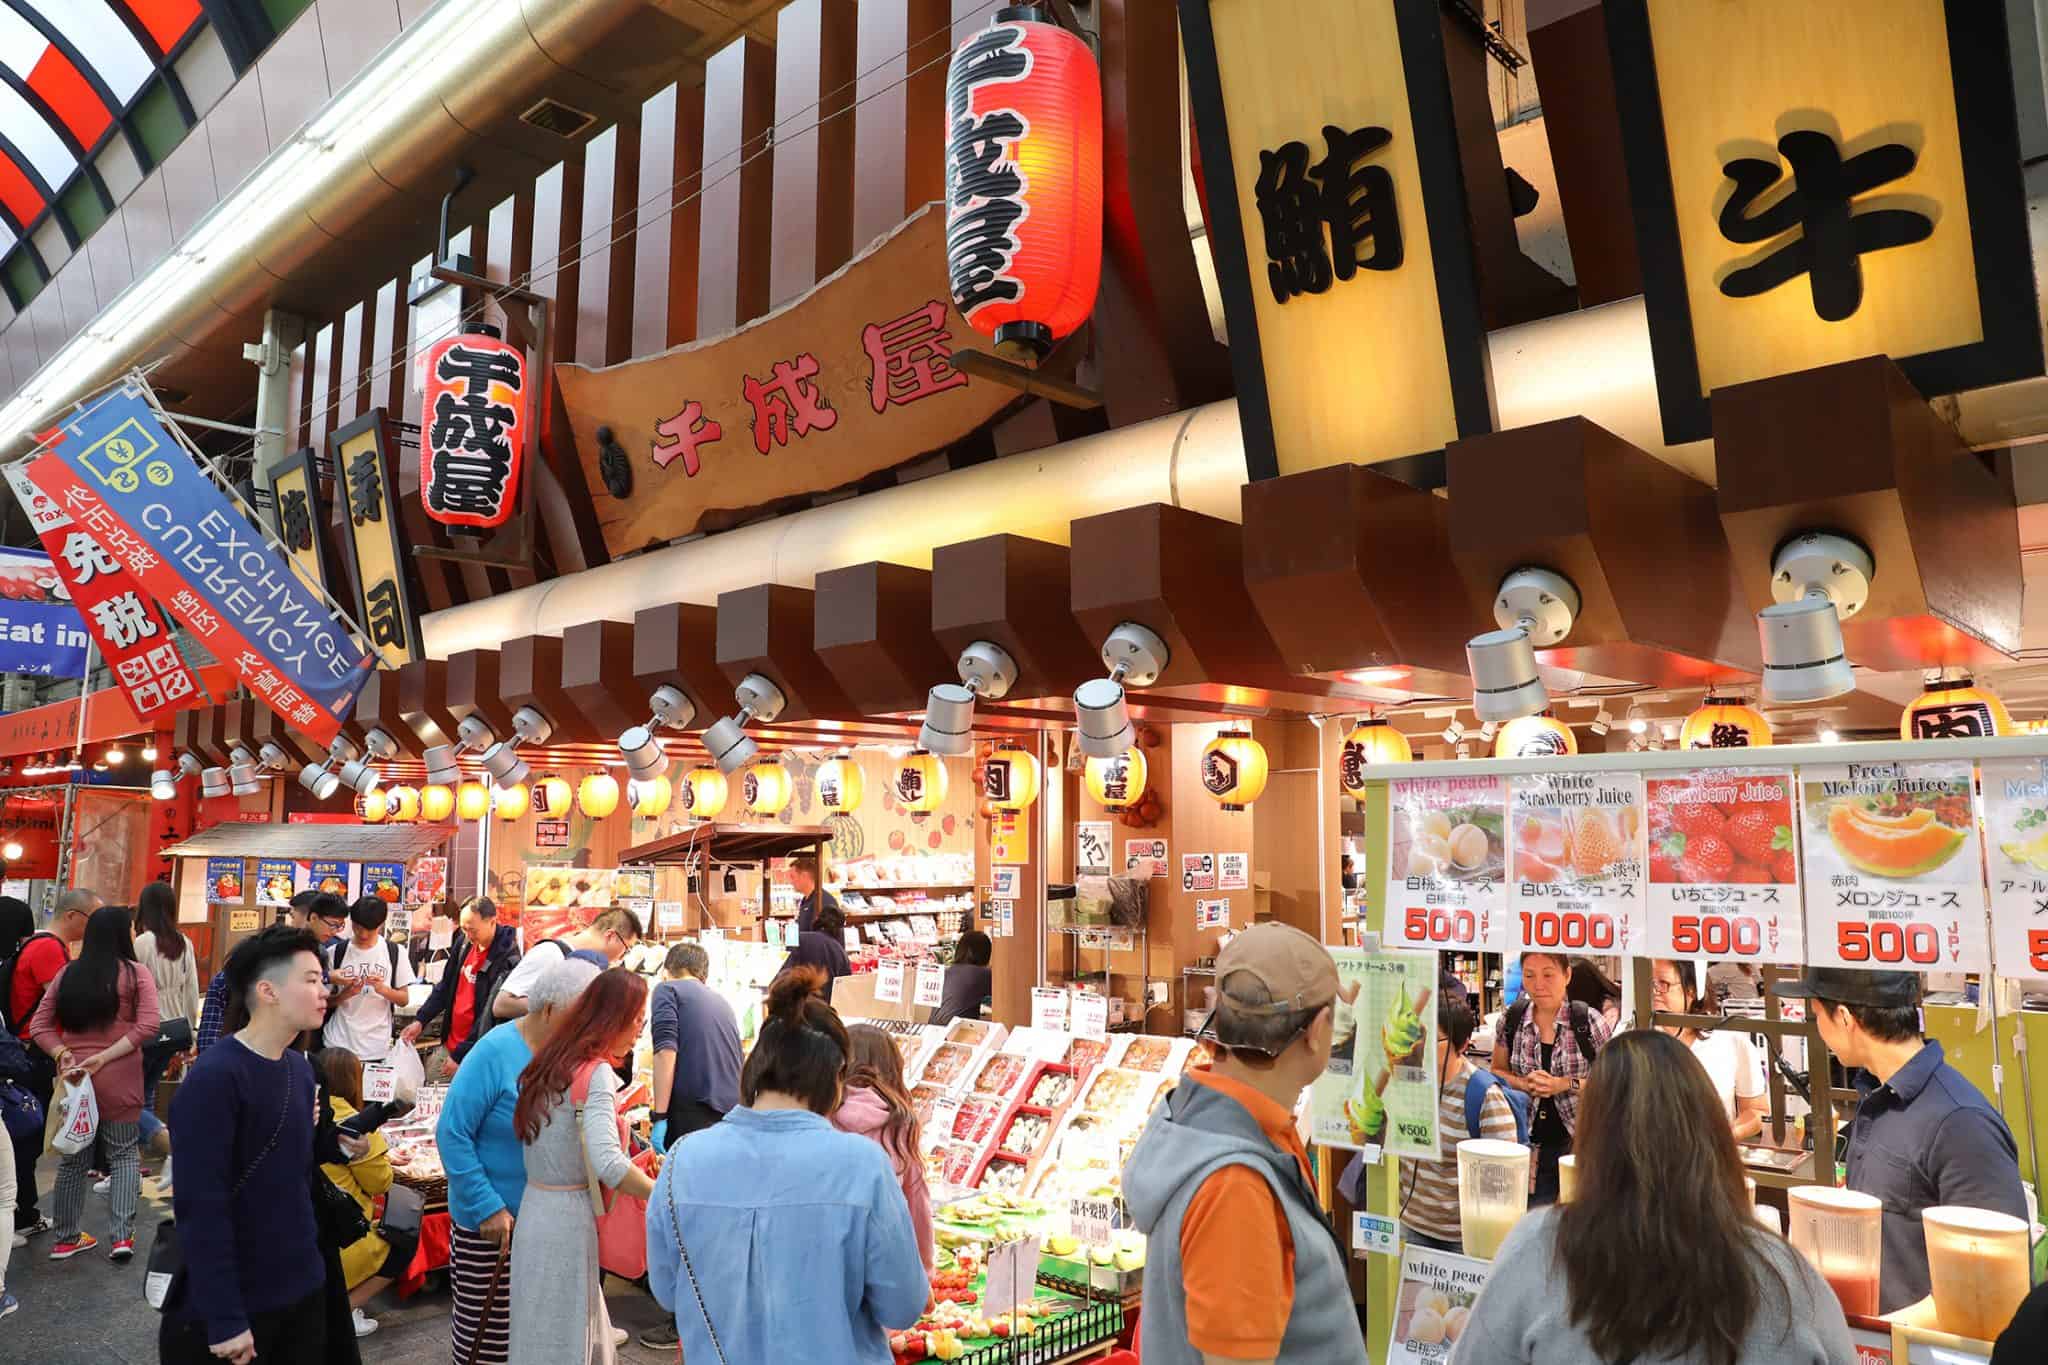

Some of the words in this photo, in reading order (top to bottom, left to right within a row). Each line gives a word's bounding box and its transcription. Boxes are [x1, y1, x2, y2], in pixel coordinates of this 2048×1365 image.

[1256, 125, 1403, 304] 鮪
[1719, 130, 1934, 323] 牛
[652, 300, 968, 477] 千成屋
[428, 345, 523, 516] 千成屋
[60, 532, 157, 649] 免税
[56, 624, 88, 648] in
[1449, 774, 1498, 793] peach
[1847, 762, 1906, 779] Fresh
[1892, 778, 1949, 793] Juice
[1596, 787, 1632, 804] Juice
[1659, 785, 1738, 804] Strawberry
[1741, 781, 1784, 802] Juice
[1837, 889, 1961, 907] メロンジュース
[1405, 907, 1476, 943] 500
[1481, 910, 1489, 945] JPY
[1519, 912, 1614, 949] 1000
[1672, 916, 1761, 955] 500
[1947, 921, 1960, 963] JPY
[1837, 922, 1940, 964] 500
[1398, 1123, 1428, 1137] ¥500
[1407, 1260, 1448, 1278] white
[1452, 1268, 1488, 1286] peac
[1432, 1279, 1465, 1294] juice
